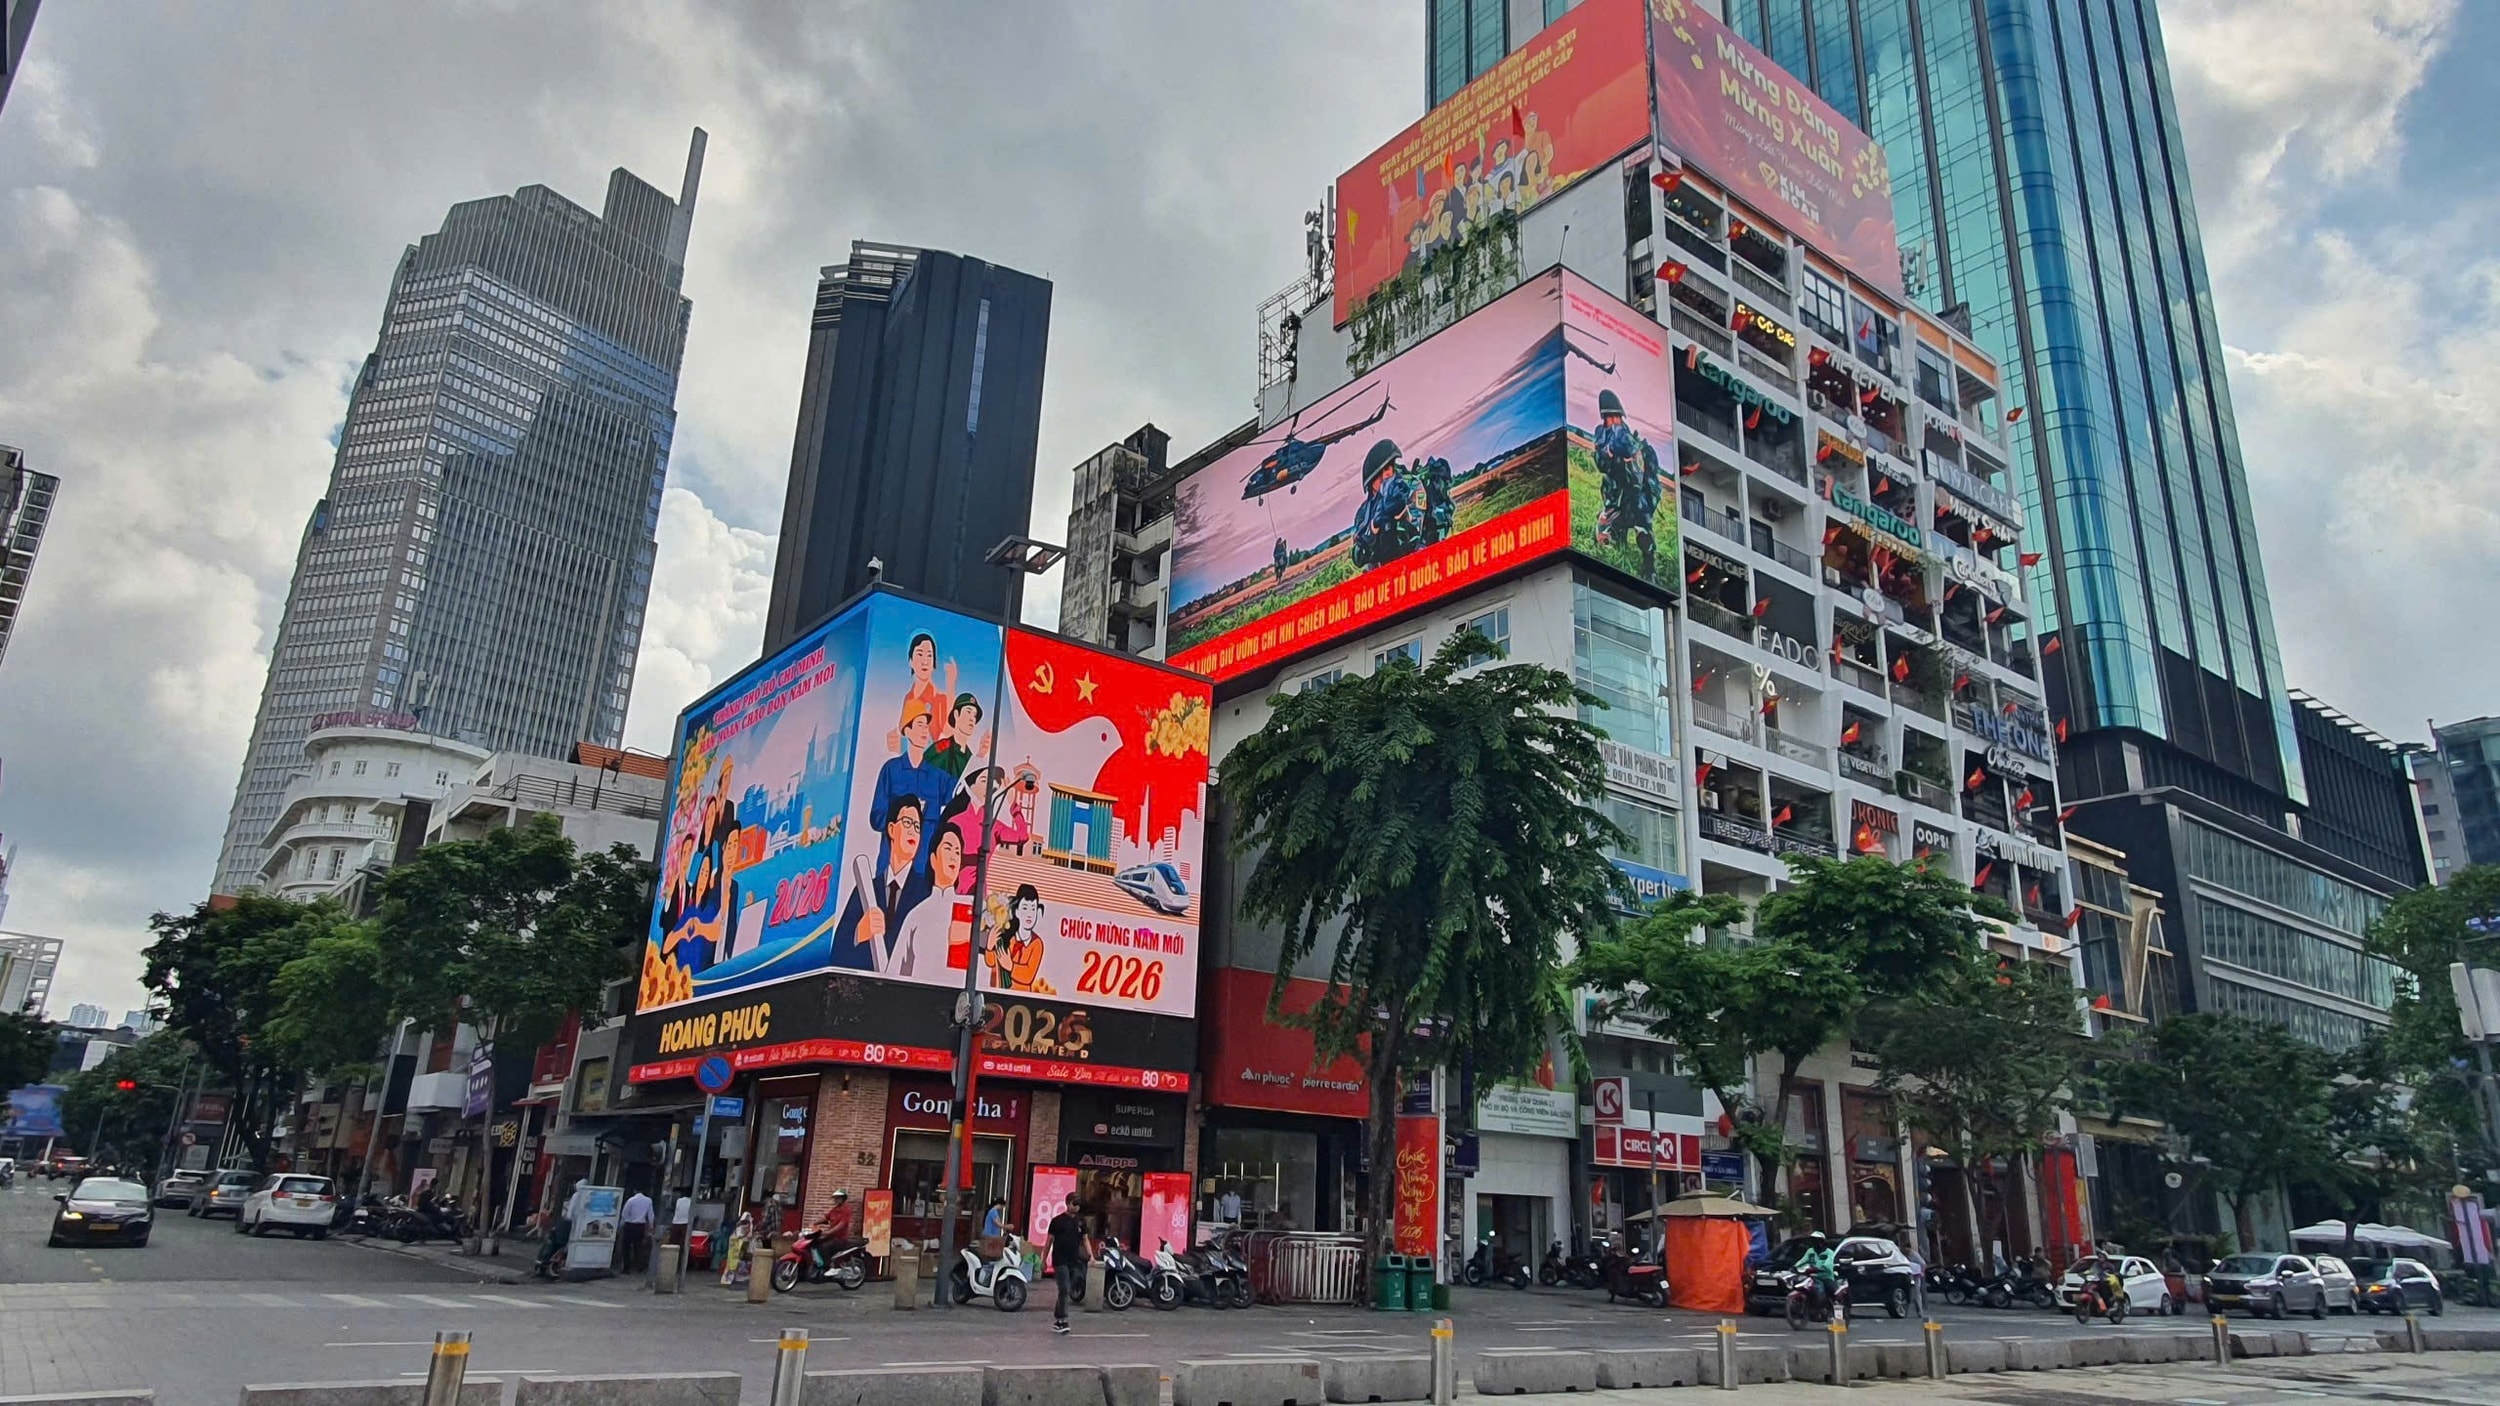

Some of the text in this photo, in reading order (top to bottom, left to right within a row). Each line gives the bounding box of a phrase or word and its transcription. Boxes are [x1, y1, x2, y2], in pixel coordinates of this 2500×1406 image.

[1716, 34, 1841, 156] Mừng Đảng
[1719, 69, 1845, 182] Mừng Xuân
[1697, 350, 1790, 424] Kangaroo
[1354, 583, 1374, 615] BẢO
[1446, 546, 1469, 577] BẢO
[1757, 625, 1820, 671] FADO
[1754, 662, 1776, 697] %
[1916, 827, 1949, 849] OOPS!
[768, 863, 833, 928] 2026
[1628, 875, 1678, 900] xpertis
[1060, 916, 1184, 956] CHÚC MỪNG NĂM MỚI
[1076, 950, 1164, 1001] 2026
[659, 1015, 715, 1055] HOANG
[720, 1002, 771, 1043] PHUC
[863, 1044, 885, 1063] 80
[1022, 1043, 1050, 1056] NEW
[1047, 1064, 1069, 1079] Sale
[1141, 1071, 1158, 1087] 80
[1303, 1077, 1329, 1089] pierre
[1331, 1080, 1359, 1092] cardin
[903, 1091, 951, 1117] Gon
[857, 1151, 877, 1167] 52
[1624, 1138, 1651, 1154] CIRCL
[1095, 1154, 1138, 1168] Kappa
[1172, 1211, 1186, 1228] 80
